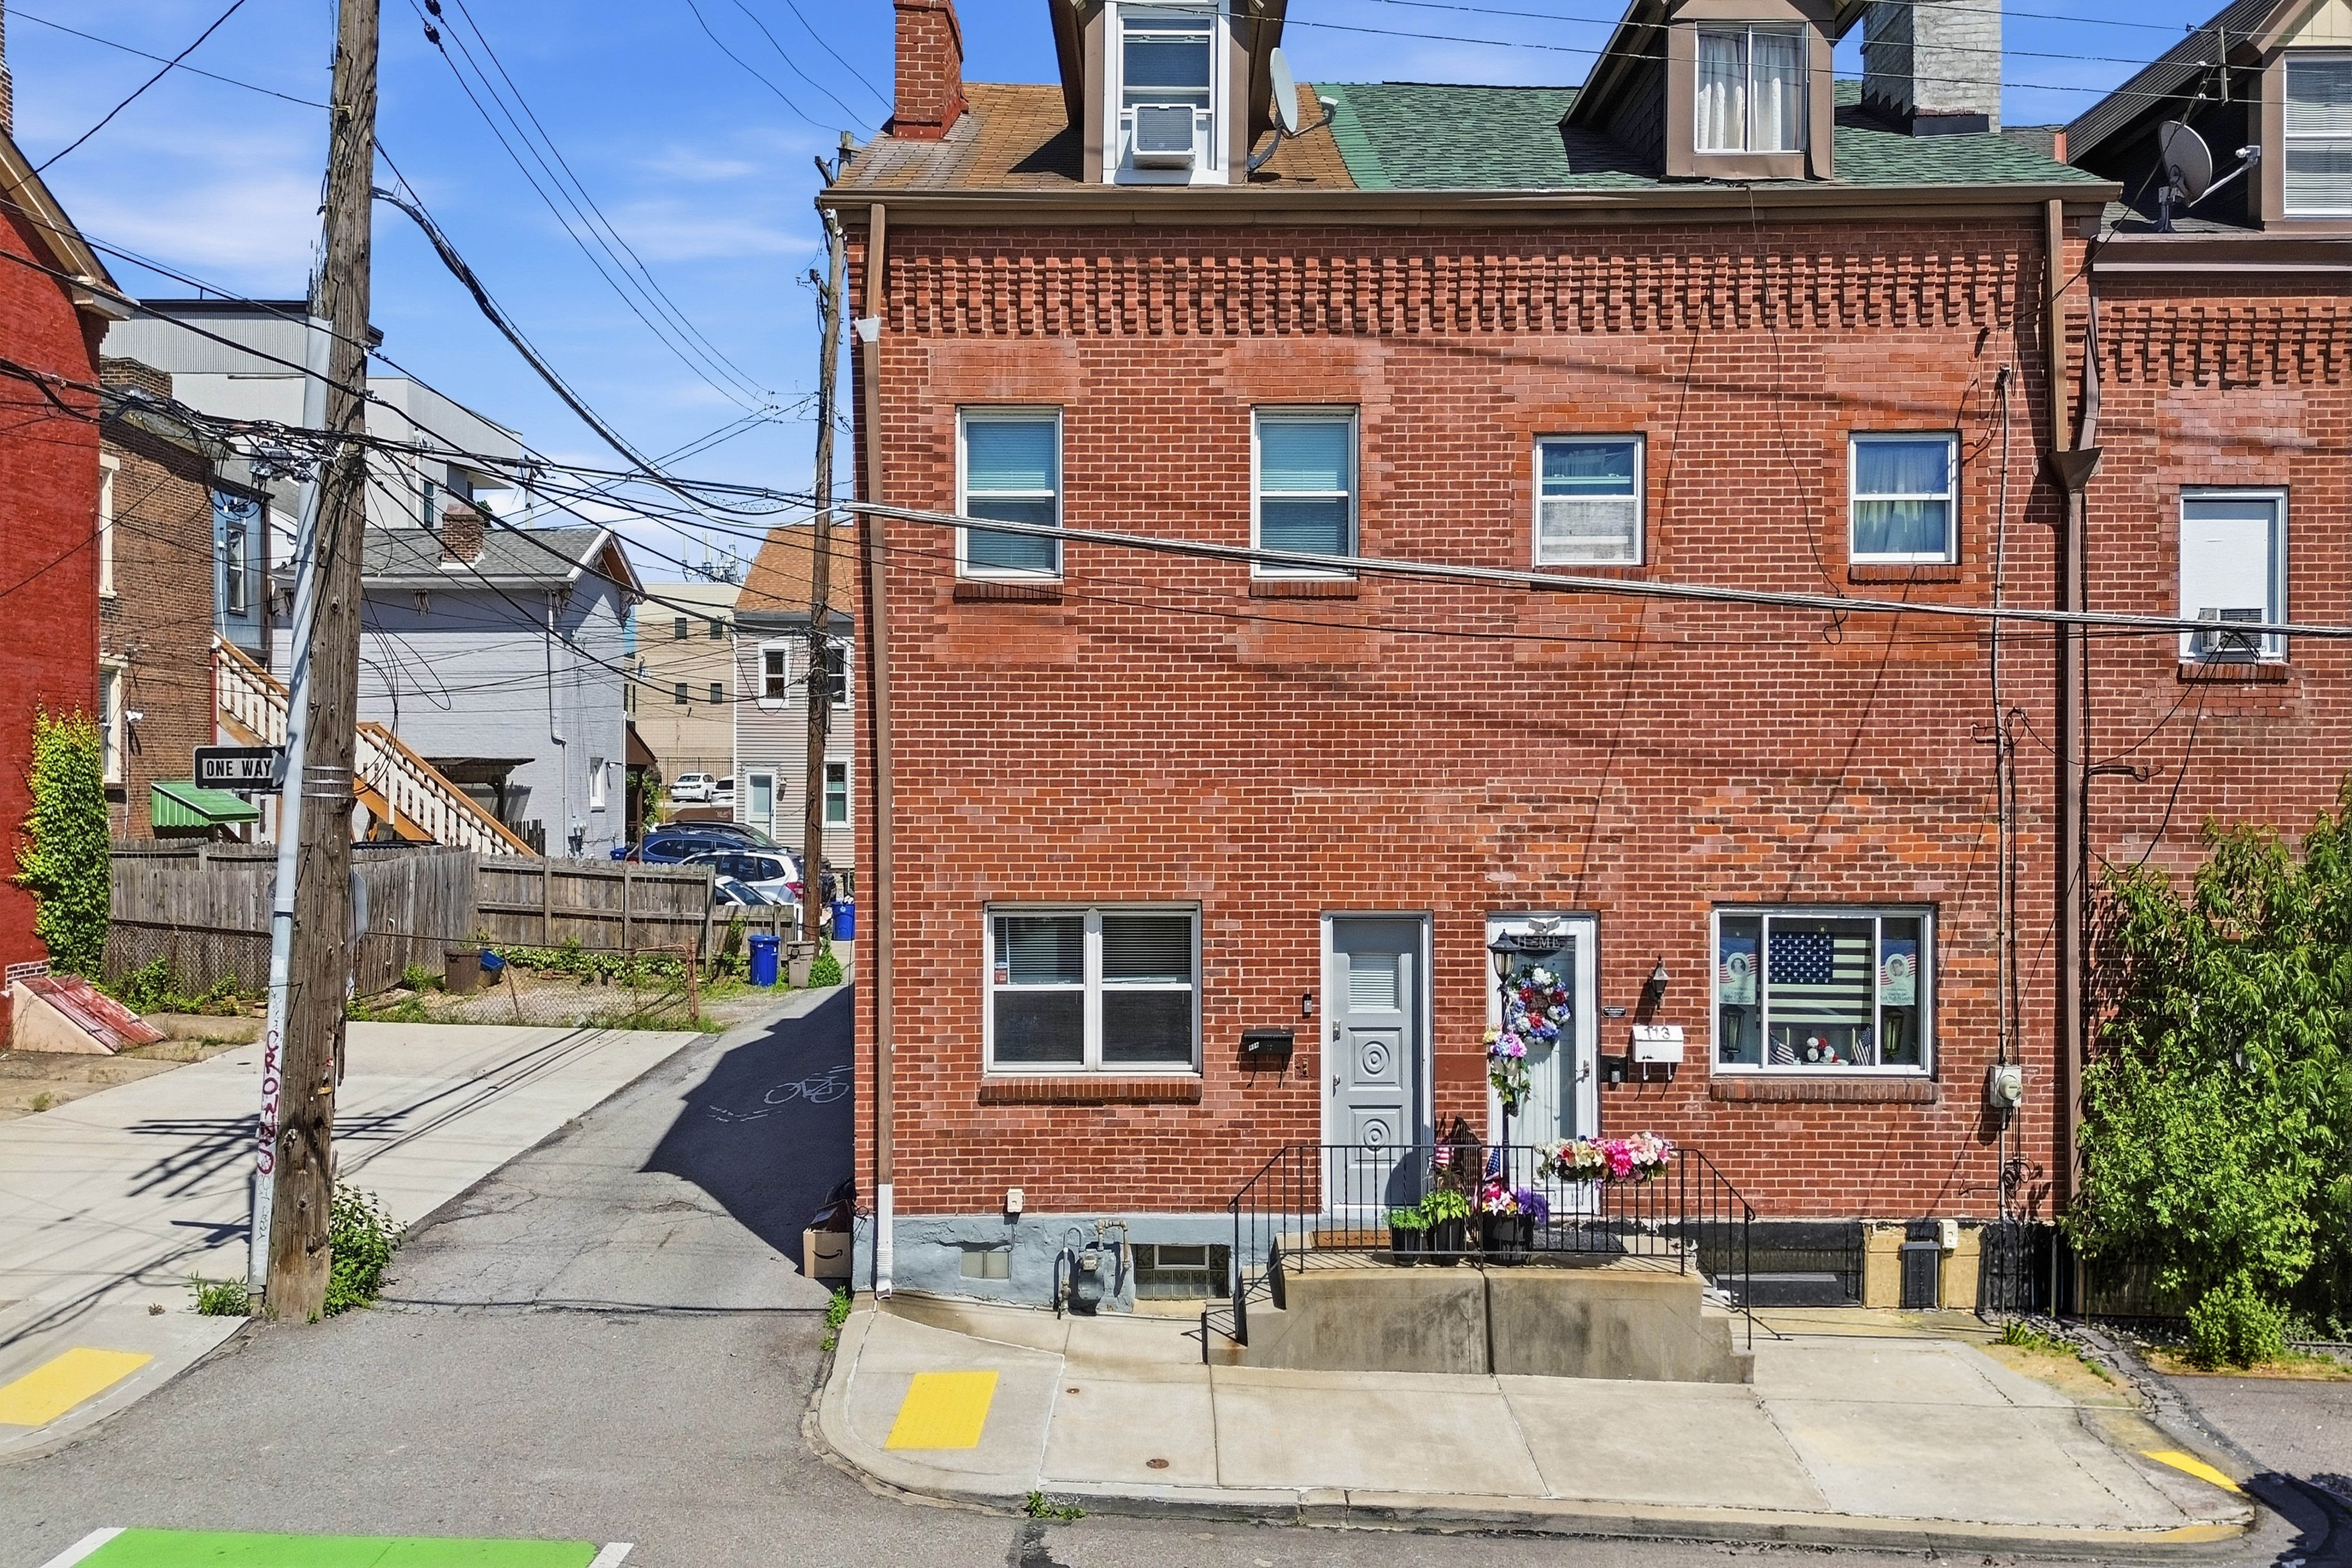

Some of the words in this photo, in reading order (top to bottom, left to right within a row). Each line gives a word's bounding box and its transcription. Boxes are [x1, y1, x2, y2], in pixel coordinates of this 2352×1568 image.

[207, 760, 233, 777] ONE
[241, 760, 271, 777] WAY
[1644, 1026, 1671, 1040] 113
